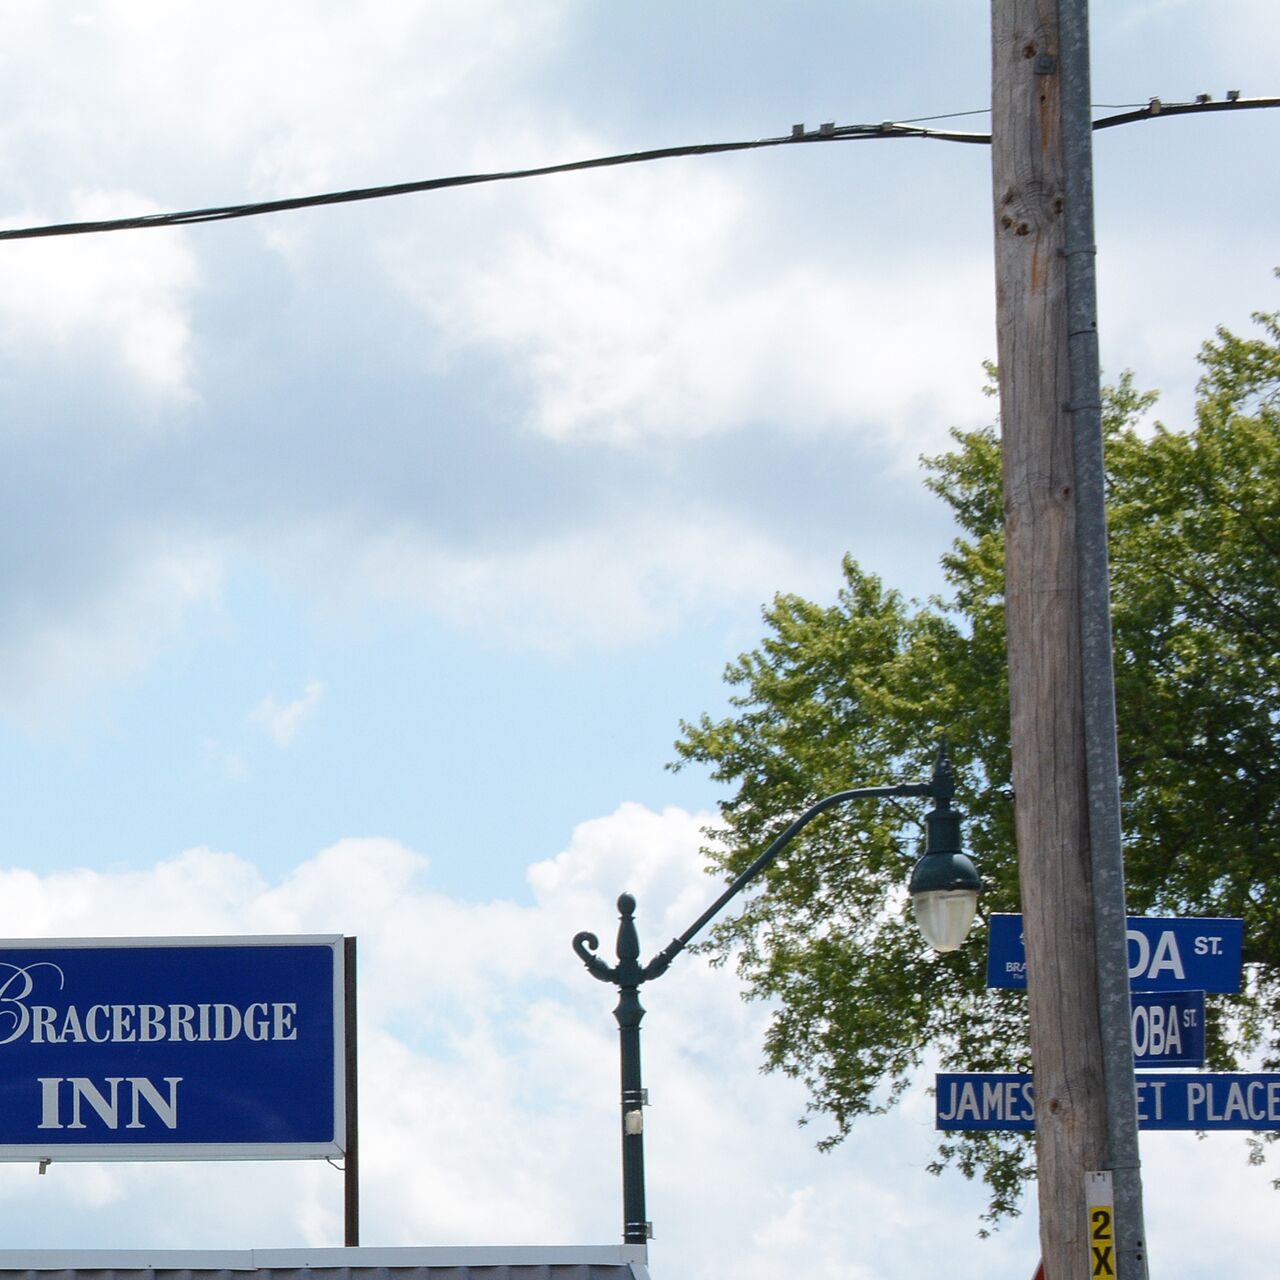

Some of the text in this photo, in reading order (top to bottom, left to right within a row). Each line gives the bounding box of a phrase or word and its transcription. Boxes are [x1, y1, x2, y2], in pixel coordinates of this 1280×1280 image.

[1194, 936, 1223, 955] ST.
[37, 1076, 183, 1129] INN
[1187, 1080, 1280, 1121] PLACE
